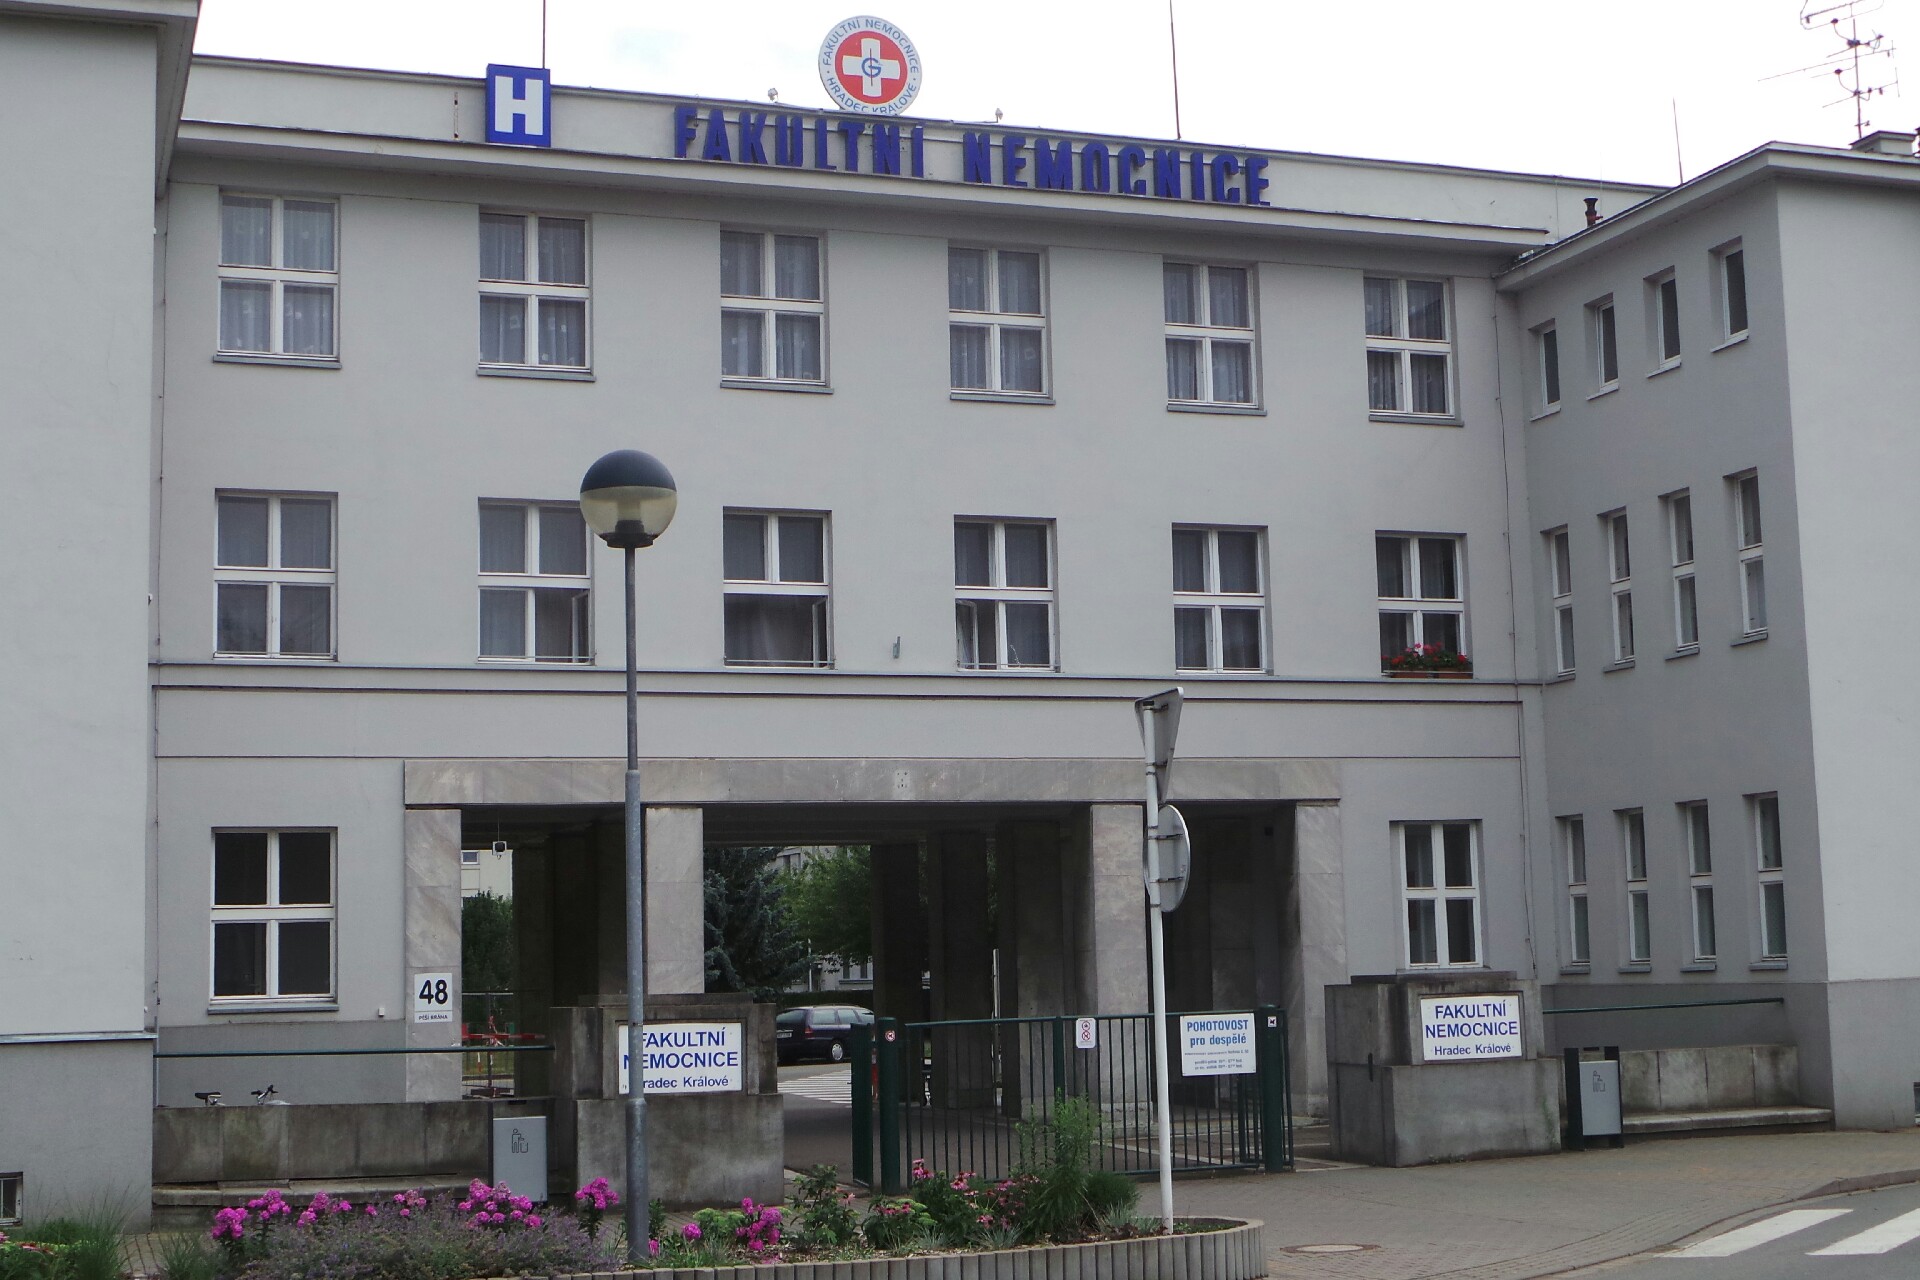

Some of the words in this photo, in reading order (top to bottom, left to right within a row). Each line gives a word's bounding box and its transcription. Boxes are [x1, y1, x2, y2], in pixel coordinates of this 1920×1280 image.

[865, 19, 919, 73] NEMOCNICE
[494, 75, 543, 136] H
[963, 131, 1270, 206] NEMOCNICE
[419, 979, 448, 1005] 48
[1435, 999, 1506, 1019] FAKULTNÍ
[1186, 1019, 1249, 1032] POHOTOVOST
[1425, 1021, 1518, 1038] NEMOCNICE
[1190, 1037, 1205, 1048] pro
[1209, 1033, 1247, 1046] dospělé
[1434, 1045, 1471, 1055] Hradec
[1475, 1043, 1511, 1054] Králové
[643, 1078, 678, 1088] radec
[683, 1075, 729, 1088] Králové
